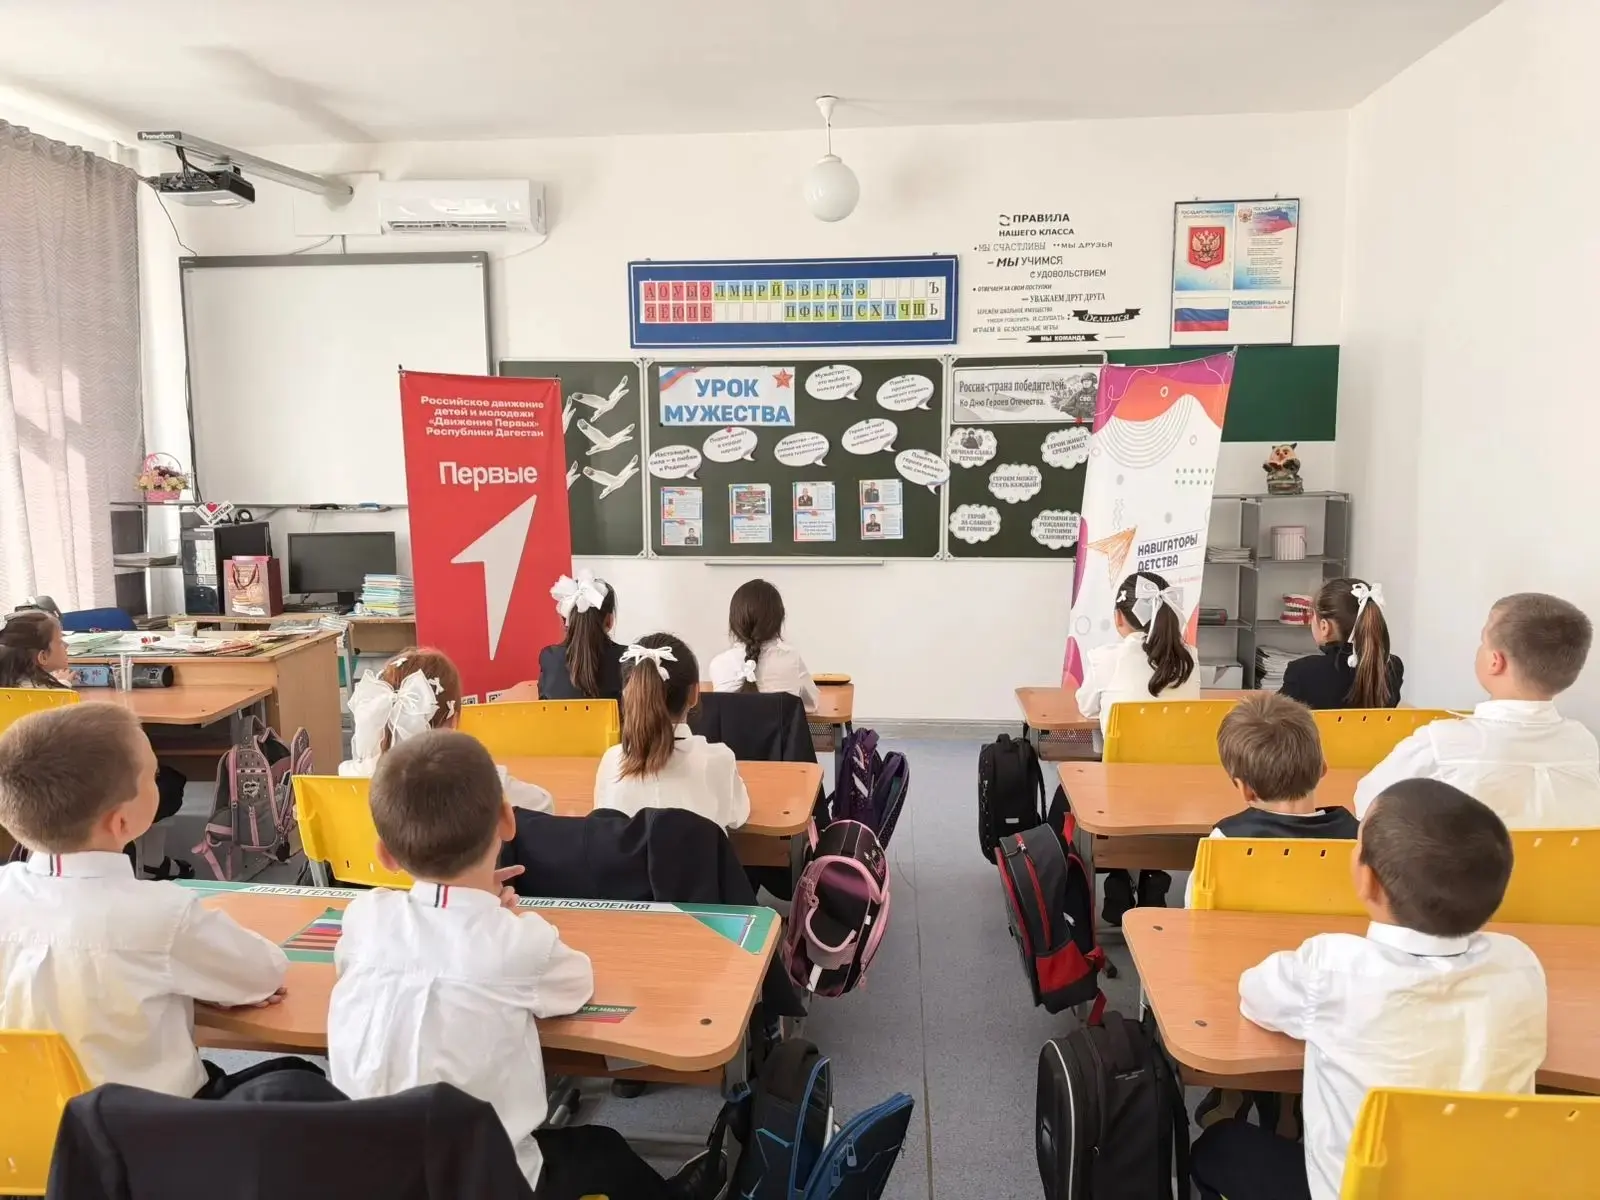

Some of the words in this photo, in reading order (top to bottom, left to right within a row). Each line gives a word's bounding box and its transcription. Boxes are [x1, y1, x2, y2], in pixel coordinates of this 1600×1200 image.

[1013, 213, 1070, 223] ПРАВИЛА
[999, 229, 1036, 237] НАШЕГО
[1039, 228, 1074, 236] КЛАССА
[993, 241, 1046, 252] СЧАСТЛИВЫ
[1078, 241, 1113, 249] ДРУЗЬЯ
[996, 257, 1019, 268] МЫ
[1021, 255, 1063, 266] УЧИМСЯ
[1036, 269, 1107, 280] УДОВОЛЬСТВИЕМ
[1029, 294, 1065, 303] УВАЖАЕМ
[1065, 293, 1083, 302] ДРУГ
[1084, 293, 1106, 302] ДРУГА
[1082, 313, 1130, 323] Делимся
[695, 378, 759, 397] УРОК
[959, 379, 1013, 396] Россия-страна
[421, 396, 489, 408] Российское
[491, 399, 544, 410] движение
[960, 399, 969, 407] Ко
[969, 399, 985, 408] Дню
[985, 398, 1009, 408] Героев
[1010, 397, 1045, 406] Отечества.
[434, 408, 468, 418] детей
[479, 409, 535, 419] молодежи
[664, 404, 792, 422] МУЖЕСТВА
[428, 418, 493, 428] «Движение
[494, 418, 539, 428] Первых»
[426, 427, 493, 439] Республики
[495, 428, 544, 438] Дагестан
[439, 461, 538, 491] Первые
[1137, 533, 1198, 557] НАВИГАТОРЫ
[1137, 554, 1178, 572] ДЕТСТВА
[249, 886, 302, 895] «ПАРТА
[305, 888, 357, 898] ГЕРОЯ»
[557, 900, 651, 910] ПОКОЛЕНИЯ
